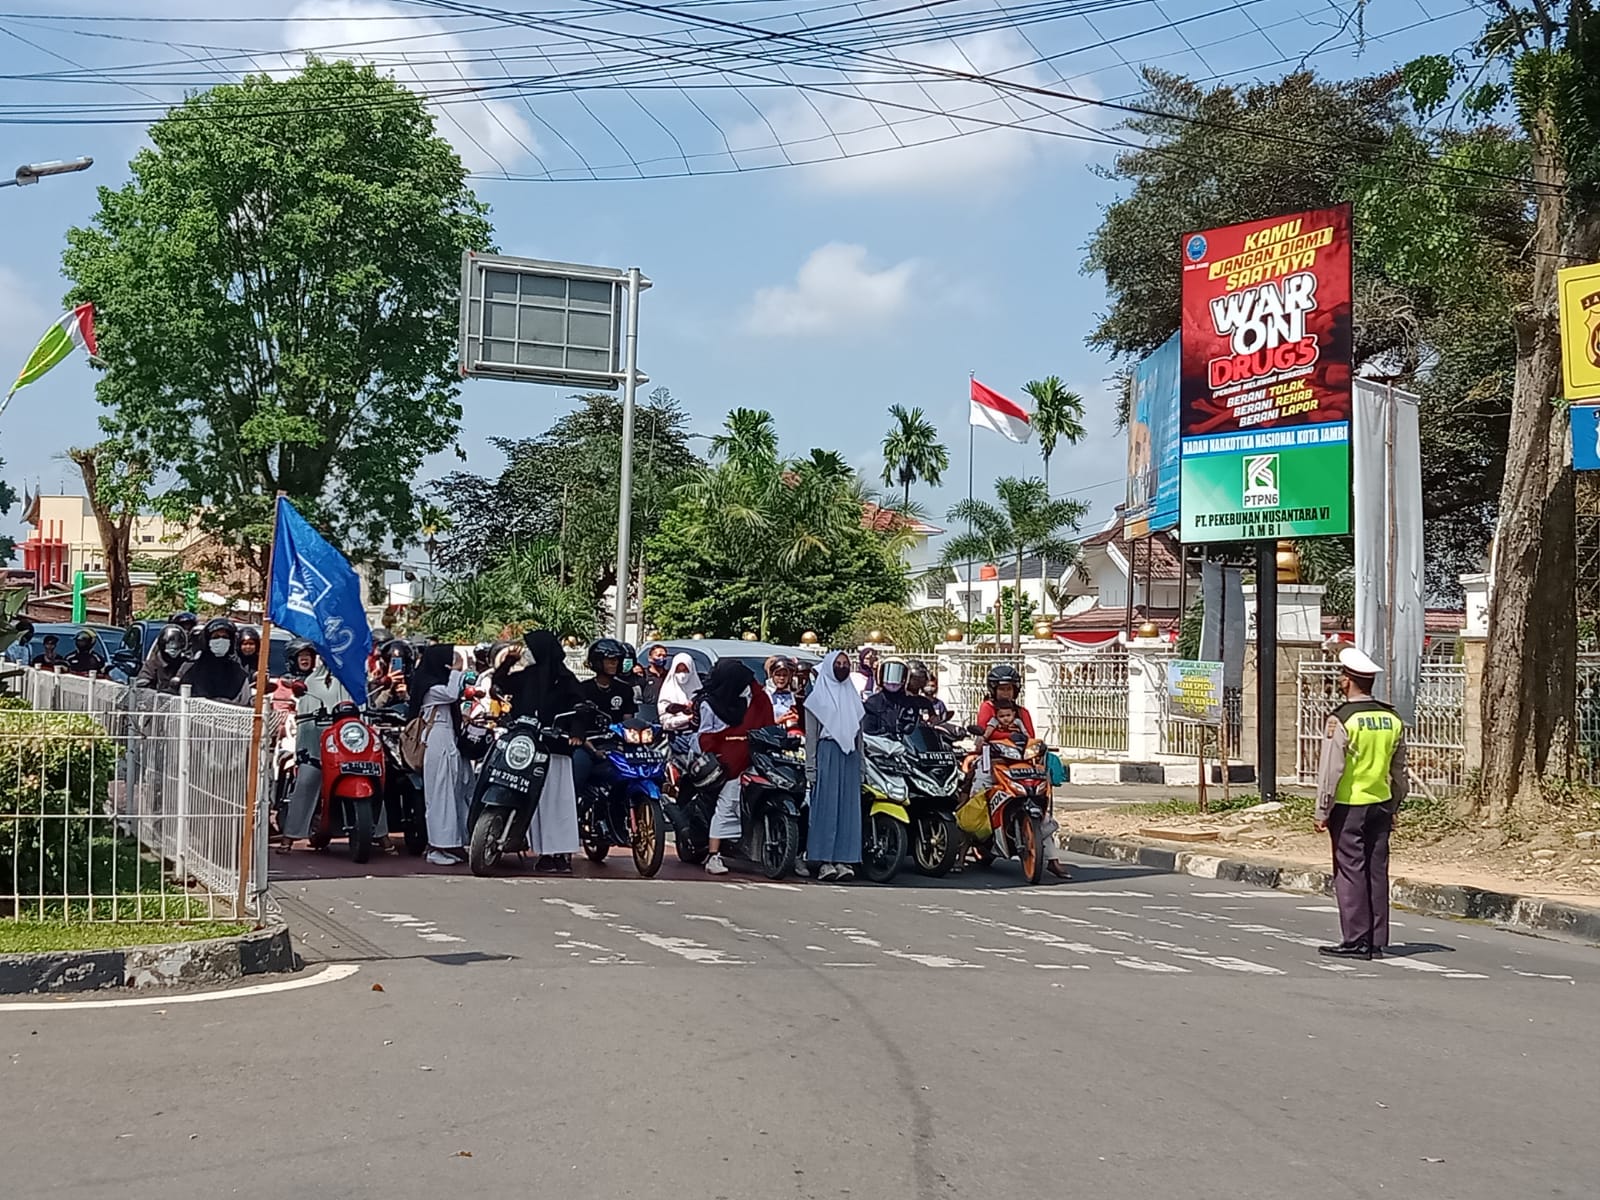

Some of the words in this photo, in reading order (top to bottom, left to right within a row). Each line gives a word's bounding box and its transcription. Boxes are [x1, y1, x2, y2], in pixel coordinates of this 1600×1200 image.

[1244, 219, 1302, 251] KAMU
[1213, 248, 1274, 276] JANGAN
[1279, 233, 1326, 257] DIAM!
[1225, 250, 1315, 291] SAATNYA
[1211, 273, 1316, 334] WAR
[1232, 309, 1303, 355] ON
[1210, 336, 1318, 388] DRUGS
[1226, 389, 1267, 408] BERANI
[1268, 379, 1306, 397] TOLAK
[1233, 398, 1273, 417] BERANI
[1275, 389, 1313, 407] REHAB
[1239, 408, 1280, 427] BERANI
[1281, 399, 1318, 417] LAPOR
[1182, 440, 1209, 455] BADAN
[1209, 435, 1254, 452] NARKOTIKA
[1255, 430, 1296, 448] NASIONAL
[1297, 428, 1319, 444] KOTA
[1320, 425, 1348, 442] JAMBI
[1244, 494, 1279, 506] PTPN6
[1262, 507, 1318, 522] NUSANTARA
[1319, 506, 1330, 520] VI
[1357, 717, 1393, 731] POLISI
